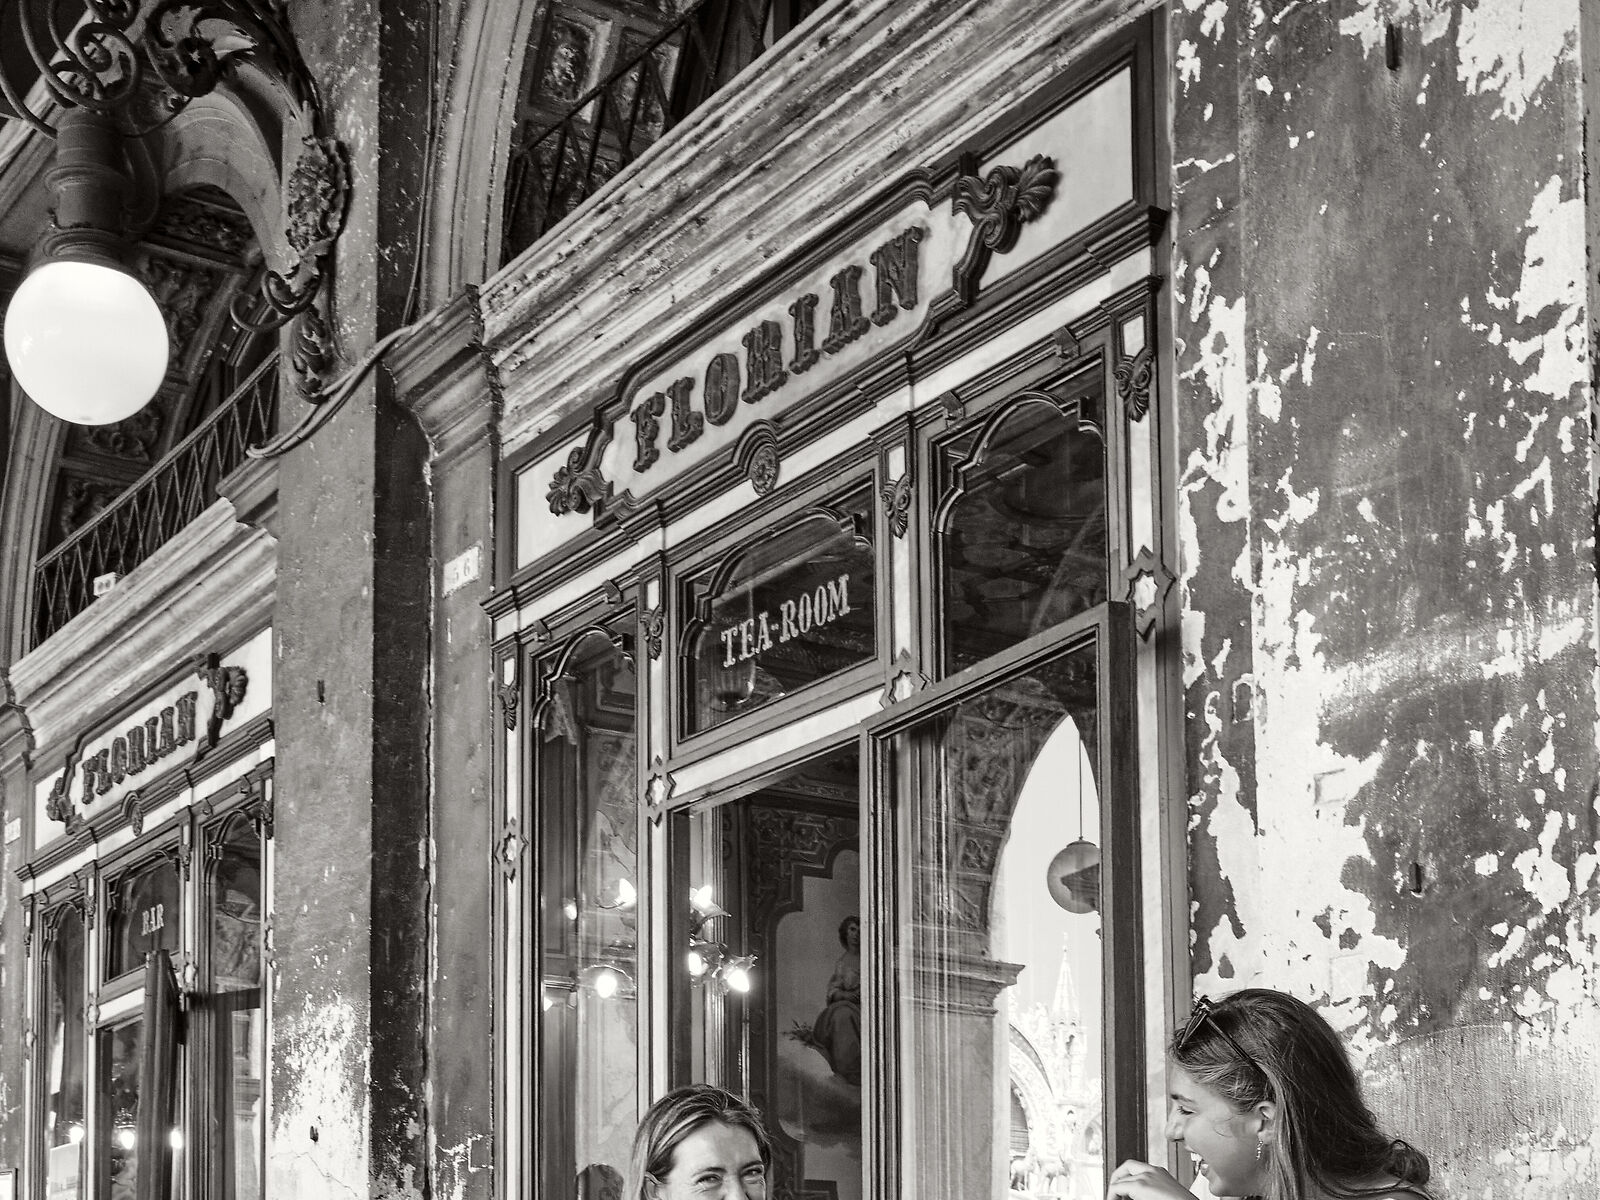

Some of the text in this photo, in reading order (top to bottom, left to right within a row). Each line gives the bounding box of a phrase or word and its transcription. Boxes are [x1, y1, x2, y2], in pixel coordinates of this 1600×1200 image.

[630, 226, 924, 473] FLORIAN
[720, 573, 850, 668] TEA-ROOM
[81, 691, 198, 805] FLORIAN
[141, 903, 164, 936] BAR
